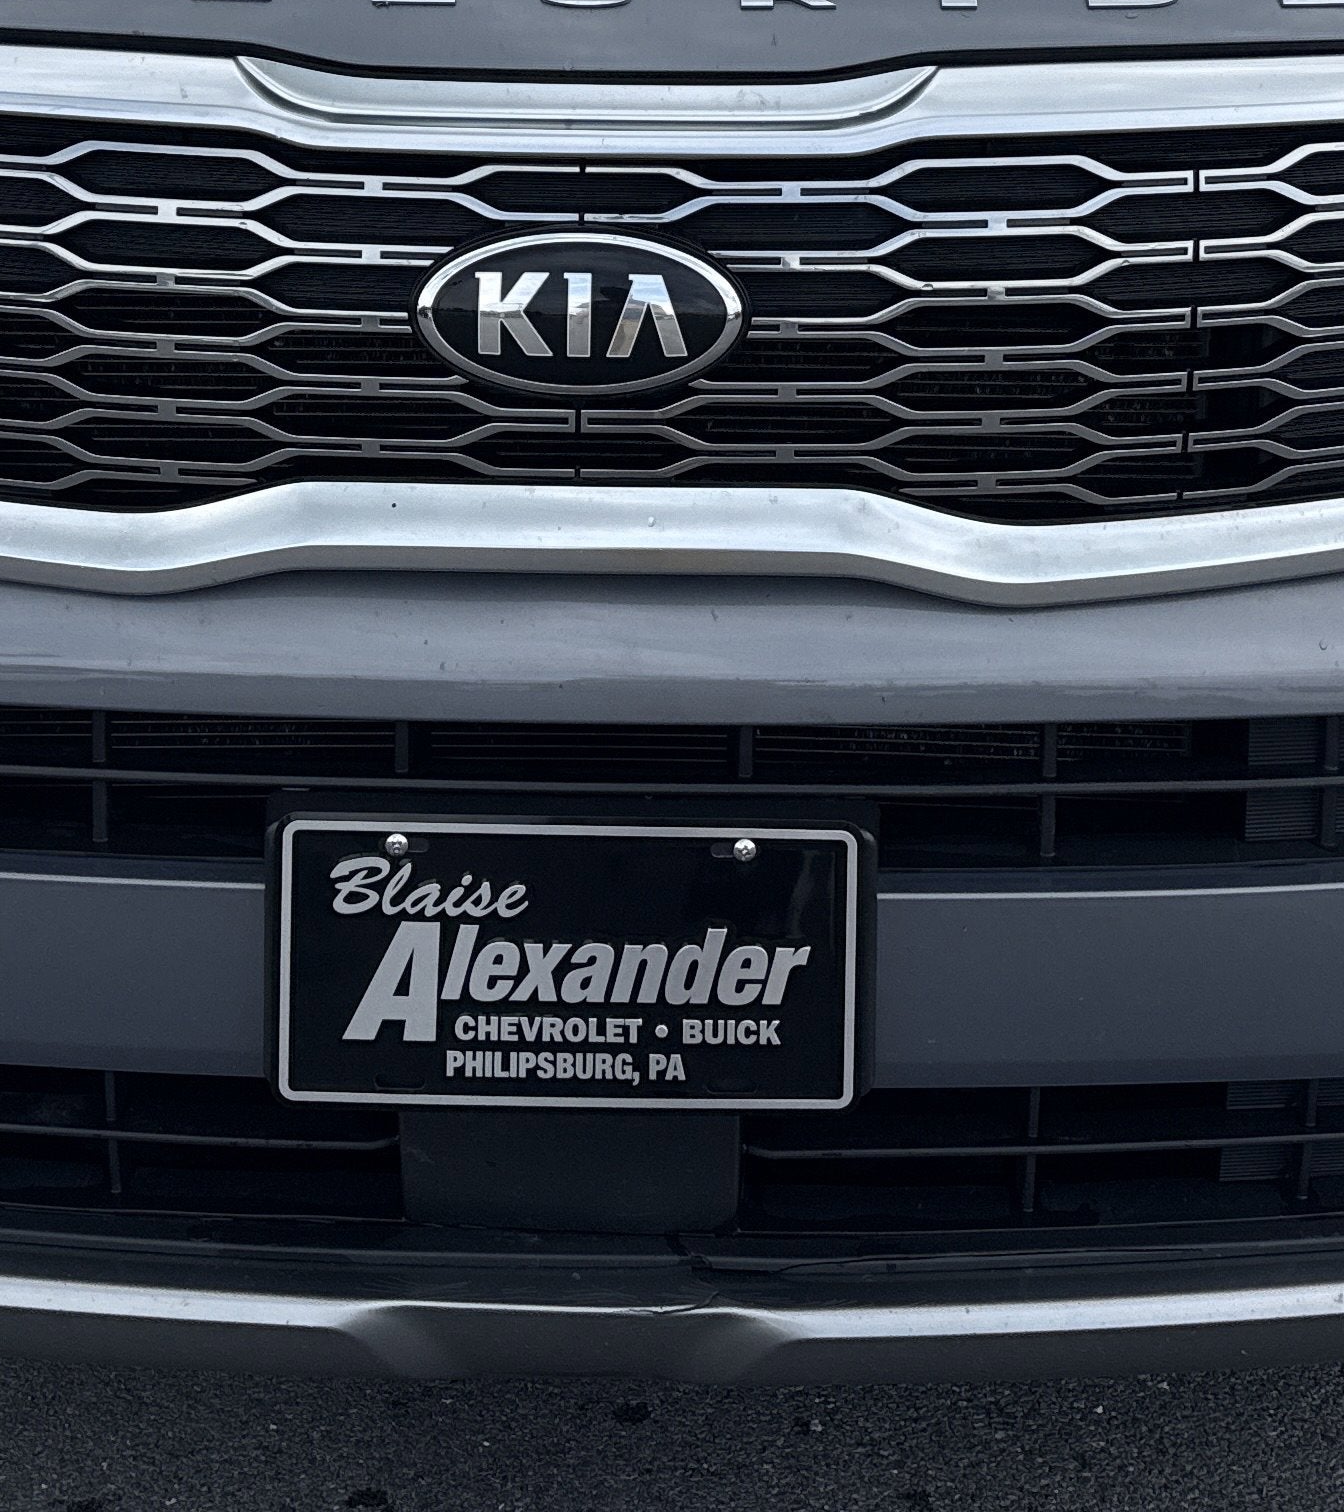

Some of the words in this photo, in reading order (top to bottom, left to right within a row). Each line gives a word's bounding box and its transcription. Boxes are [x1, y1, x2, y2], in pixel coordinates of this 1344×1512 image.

[474, 271, 688, 358] KIA
[329, 856, 528, 918] Blaise
[342, 921, 811, 1042] Alexander
[454, 1016, 643, 1044] CHEVROLET
[682, 1019, 782, 1046] BUICK
[446, 1050, 640, 1085] PHILIPSBURG,
[648, 1053, 687, 1081] PA
